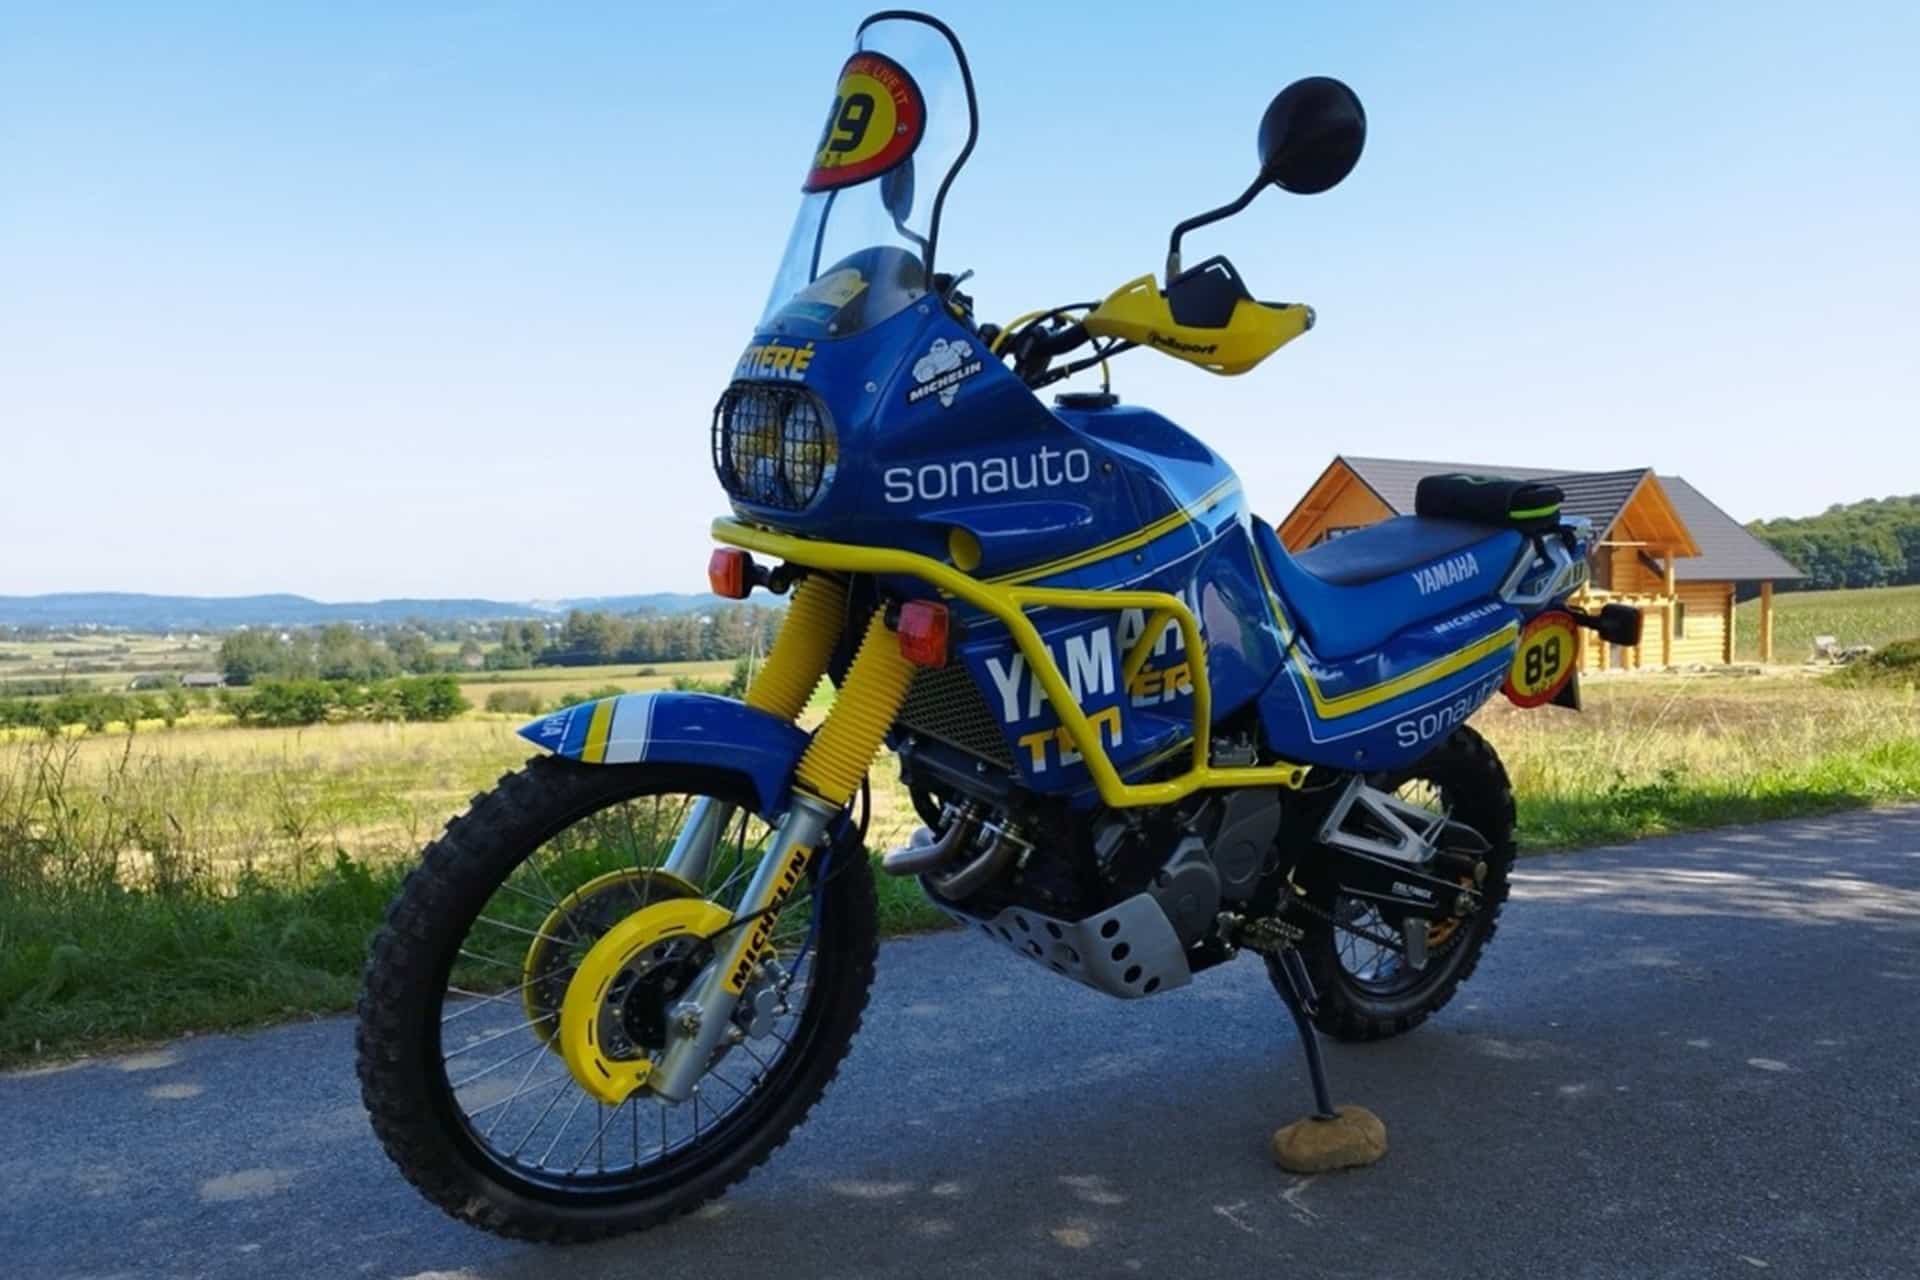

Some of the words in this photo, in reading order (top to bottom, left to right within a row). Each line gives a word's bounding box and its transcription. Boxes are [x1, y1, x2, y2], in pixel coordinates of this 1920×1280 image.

[908, 361, 982, 403] MICHELIN
[883, 445, 1091, 503] sonauto
[1412, 551, 1480, 596] YAMAHA
[1432, 602, 1503, 634] MICHELIN
[1524, 636, 1561, 686] 89
[731, 850, 806, 990] MICHELIN
